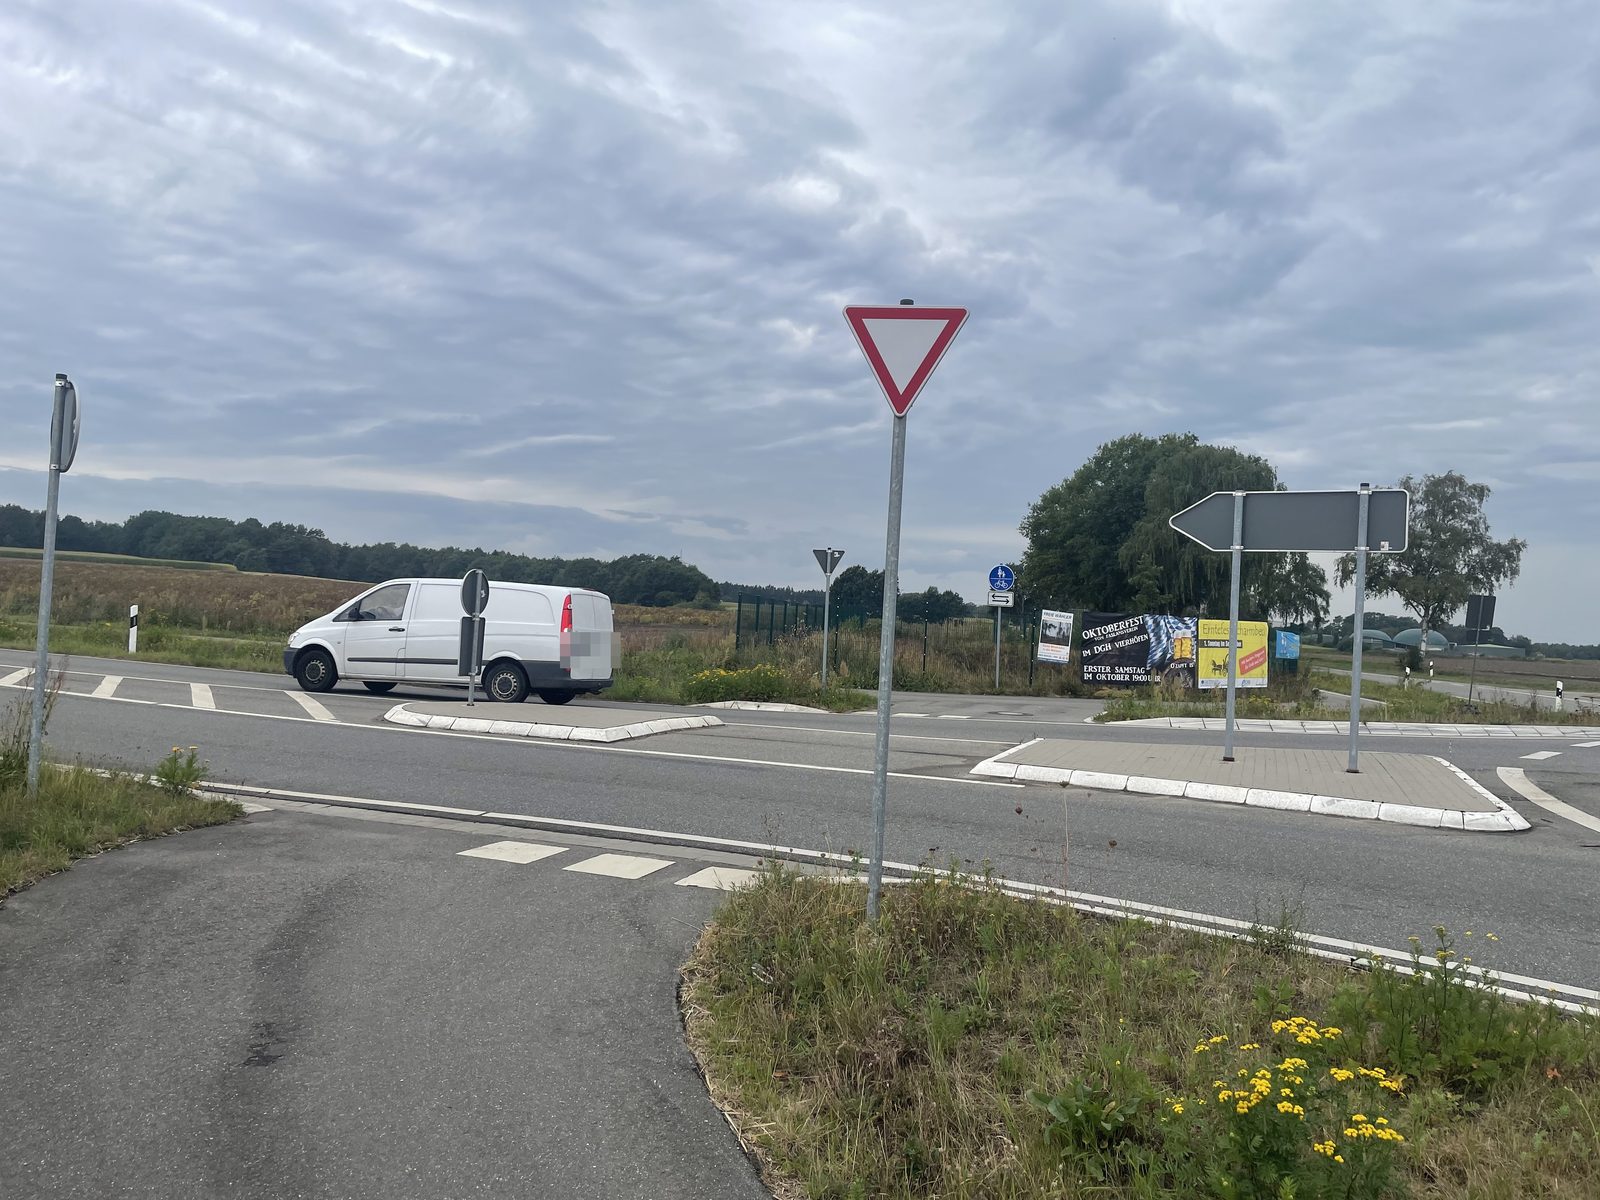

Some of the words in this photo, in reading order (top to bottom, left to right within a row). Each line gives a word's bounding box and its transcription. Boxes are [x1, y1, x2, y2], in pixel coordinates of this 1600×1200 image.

[1082, 615, 1144, 640] OKTOBERFEST
[1082, 649, 1092, 657] IM
[1094, 643, 1112, 654] DGH
[1114, 633, 1149, 649] VIERHÖFEN
[1083, 665, 1111, 673] ERSTER
[1115, 666, 1146, 674] SAMSTAG
[1096, 673, 1130, 682] OKTOBER
